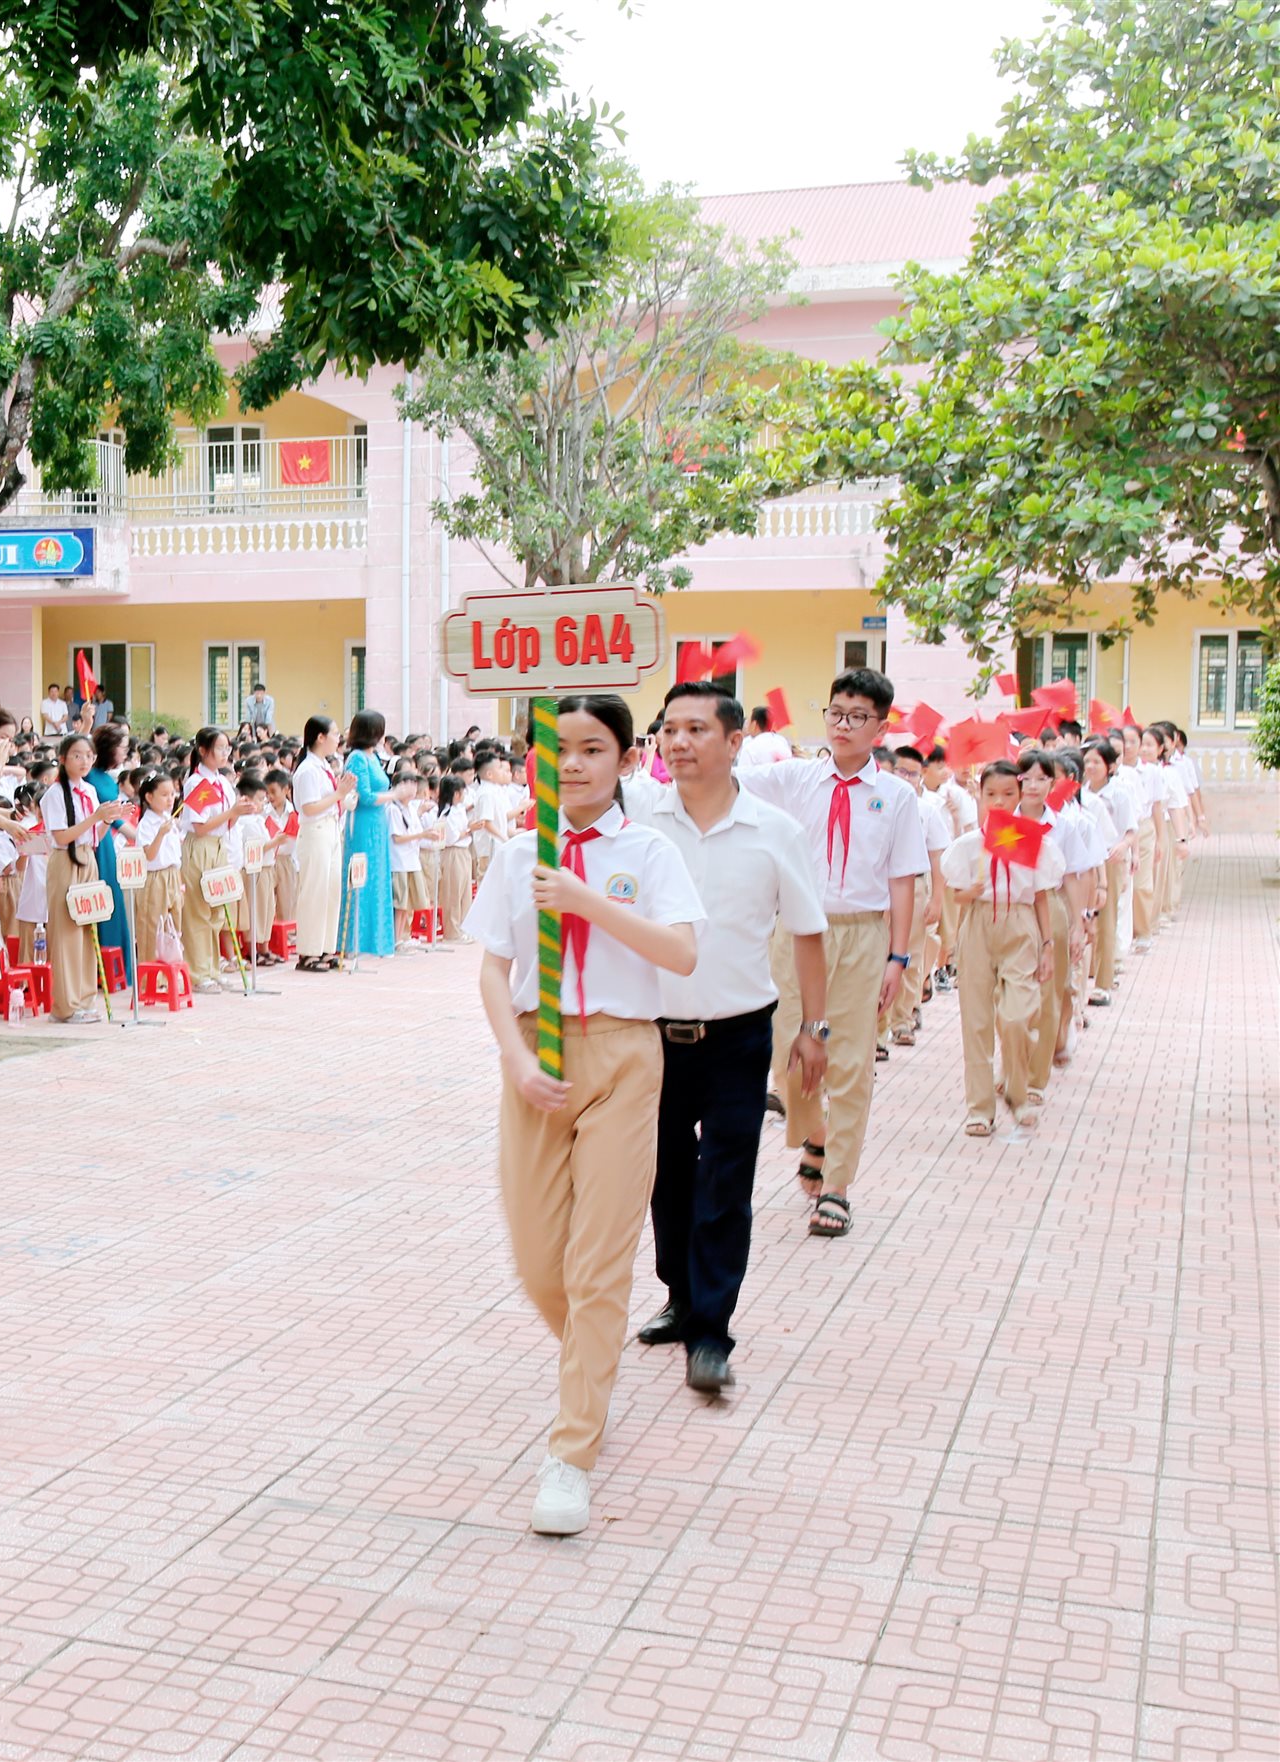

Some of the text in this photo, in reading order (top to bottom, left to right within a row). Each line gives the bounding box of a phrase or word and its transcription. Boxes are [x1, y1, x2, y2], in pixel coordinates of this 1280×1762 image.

[472, 614, 634, 673] Lớp 6A4
[93, 891, 106, 911] 1A
